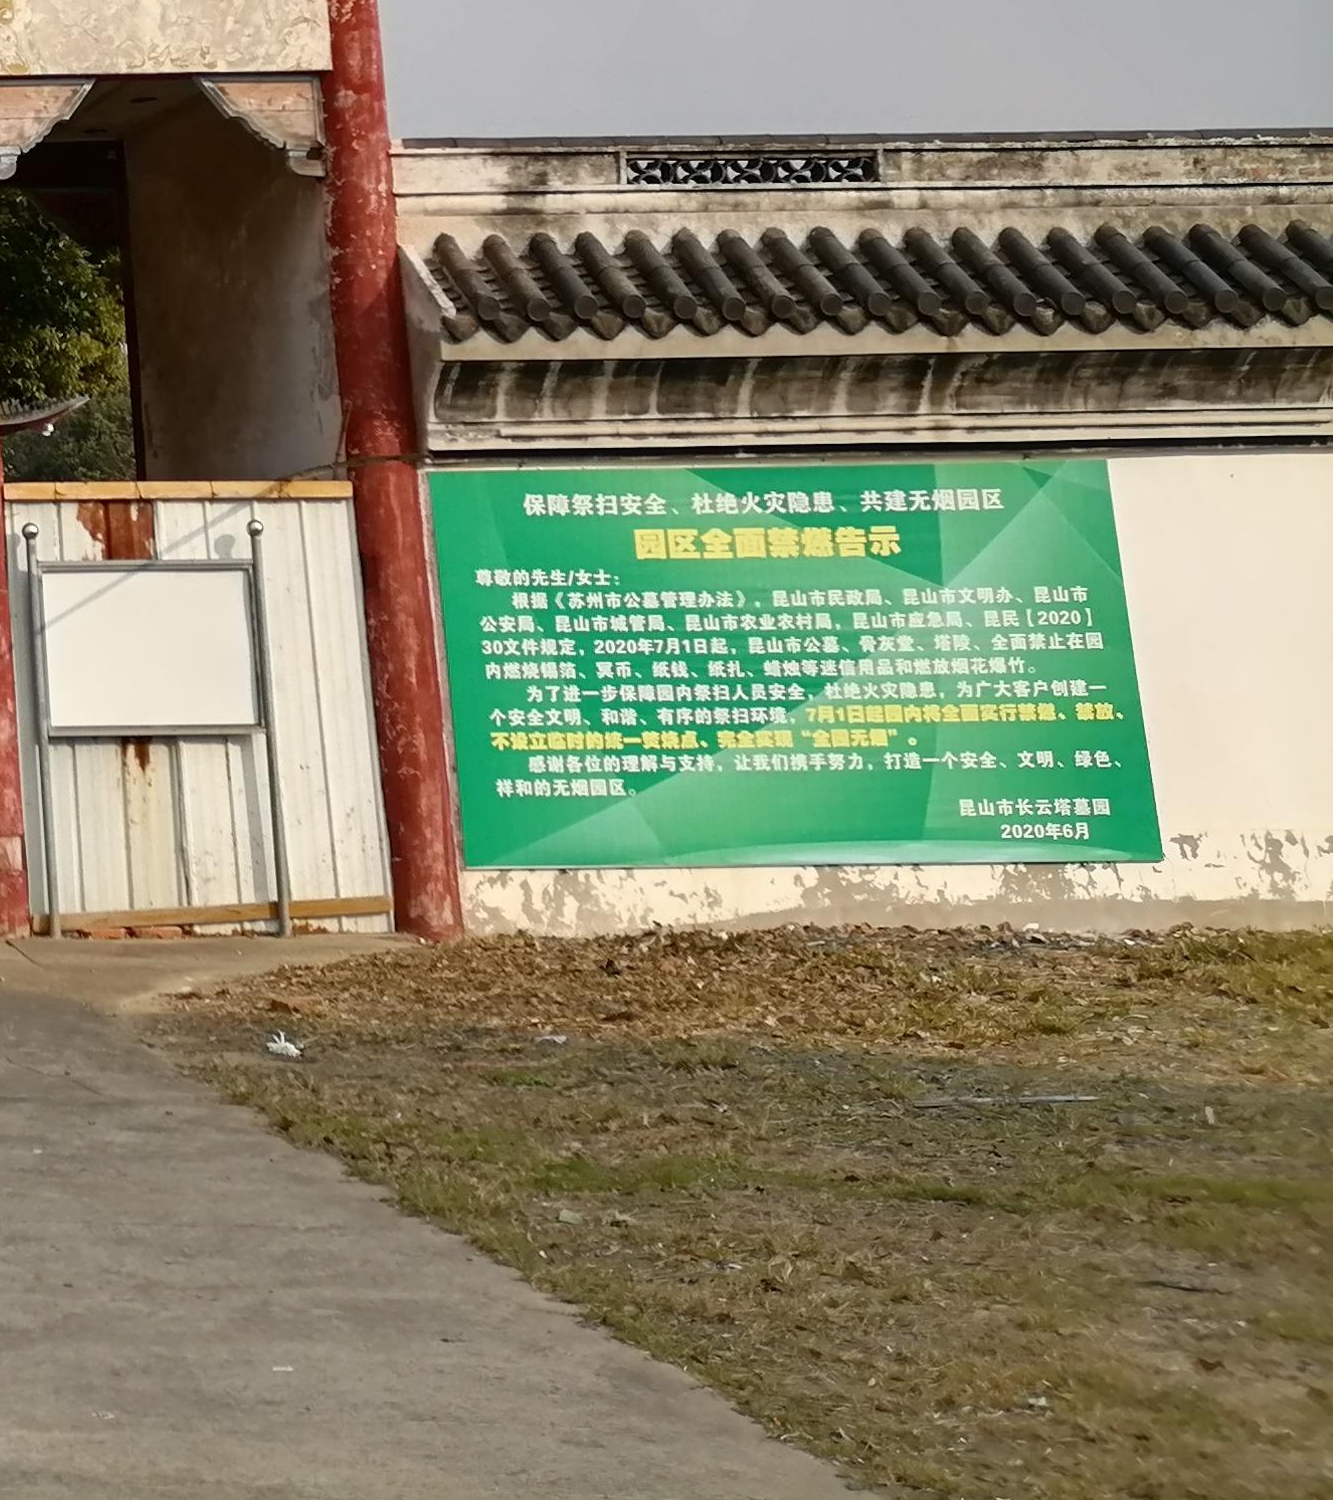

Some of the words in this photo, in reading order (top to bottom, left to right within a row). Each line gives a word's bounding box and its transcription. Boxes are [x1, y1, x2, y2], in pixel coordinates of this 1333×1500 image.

[523, 488, 1004, 517] 保障祭扫安全、杜绝火灾隐患、共建无烟园区
[634, 525, 901, 560] 园区全面禁燃告示
[496, 779, 637, 798] 祥和的无烟园区。
[959, 798, 1111, 817] 昆山市长云塔墓园
[1001, 822, 1091, 840] 2020年6月
